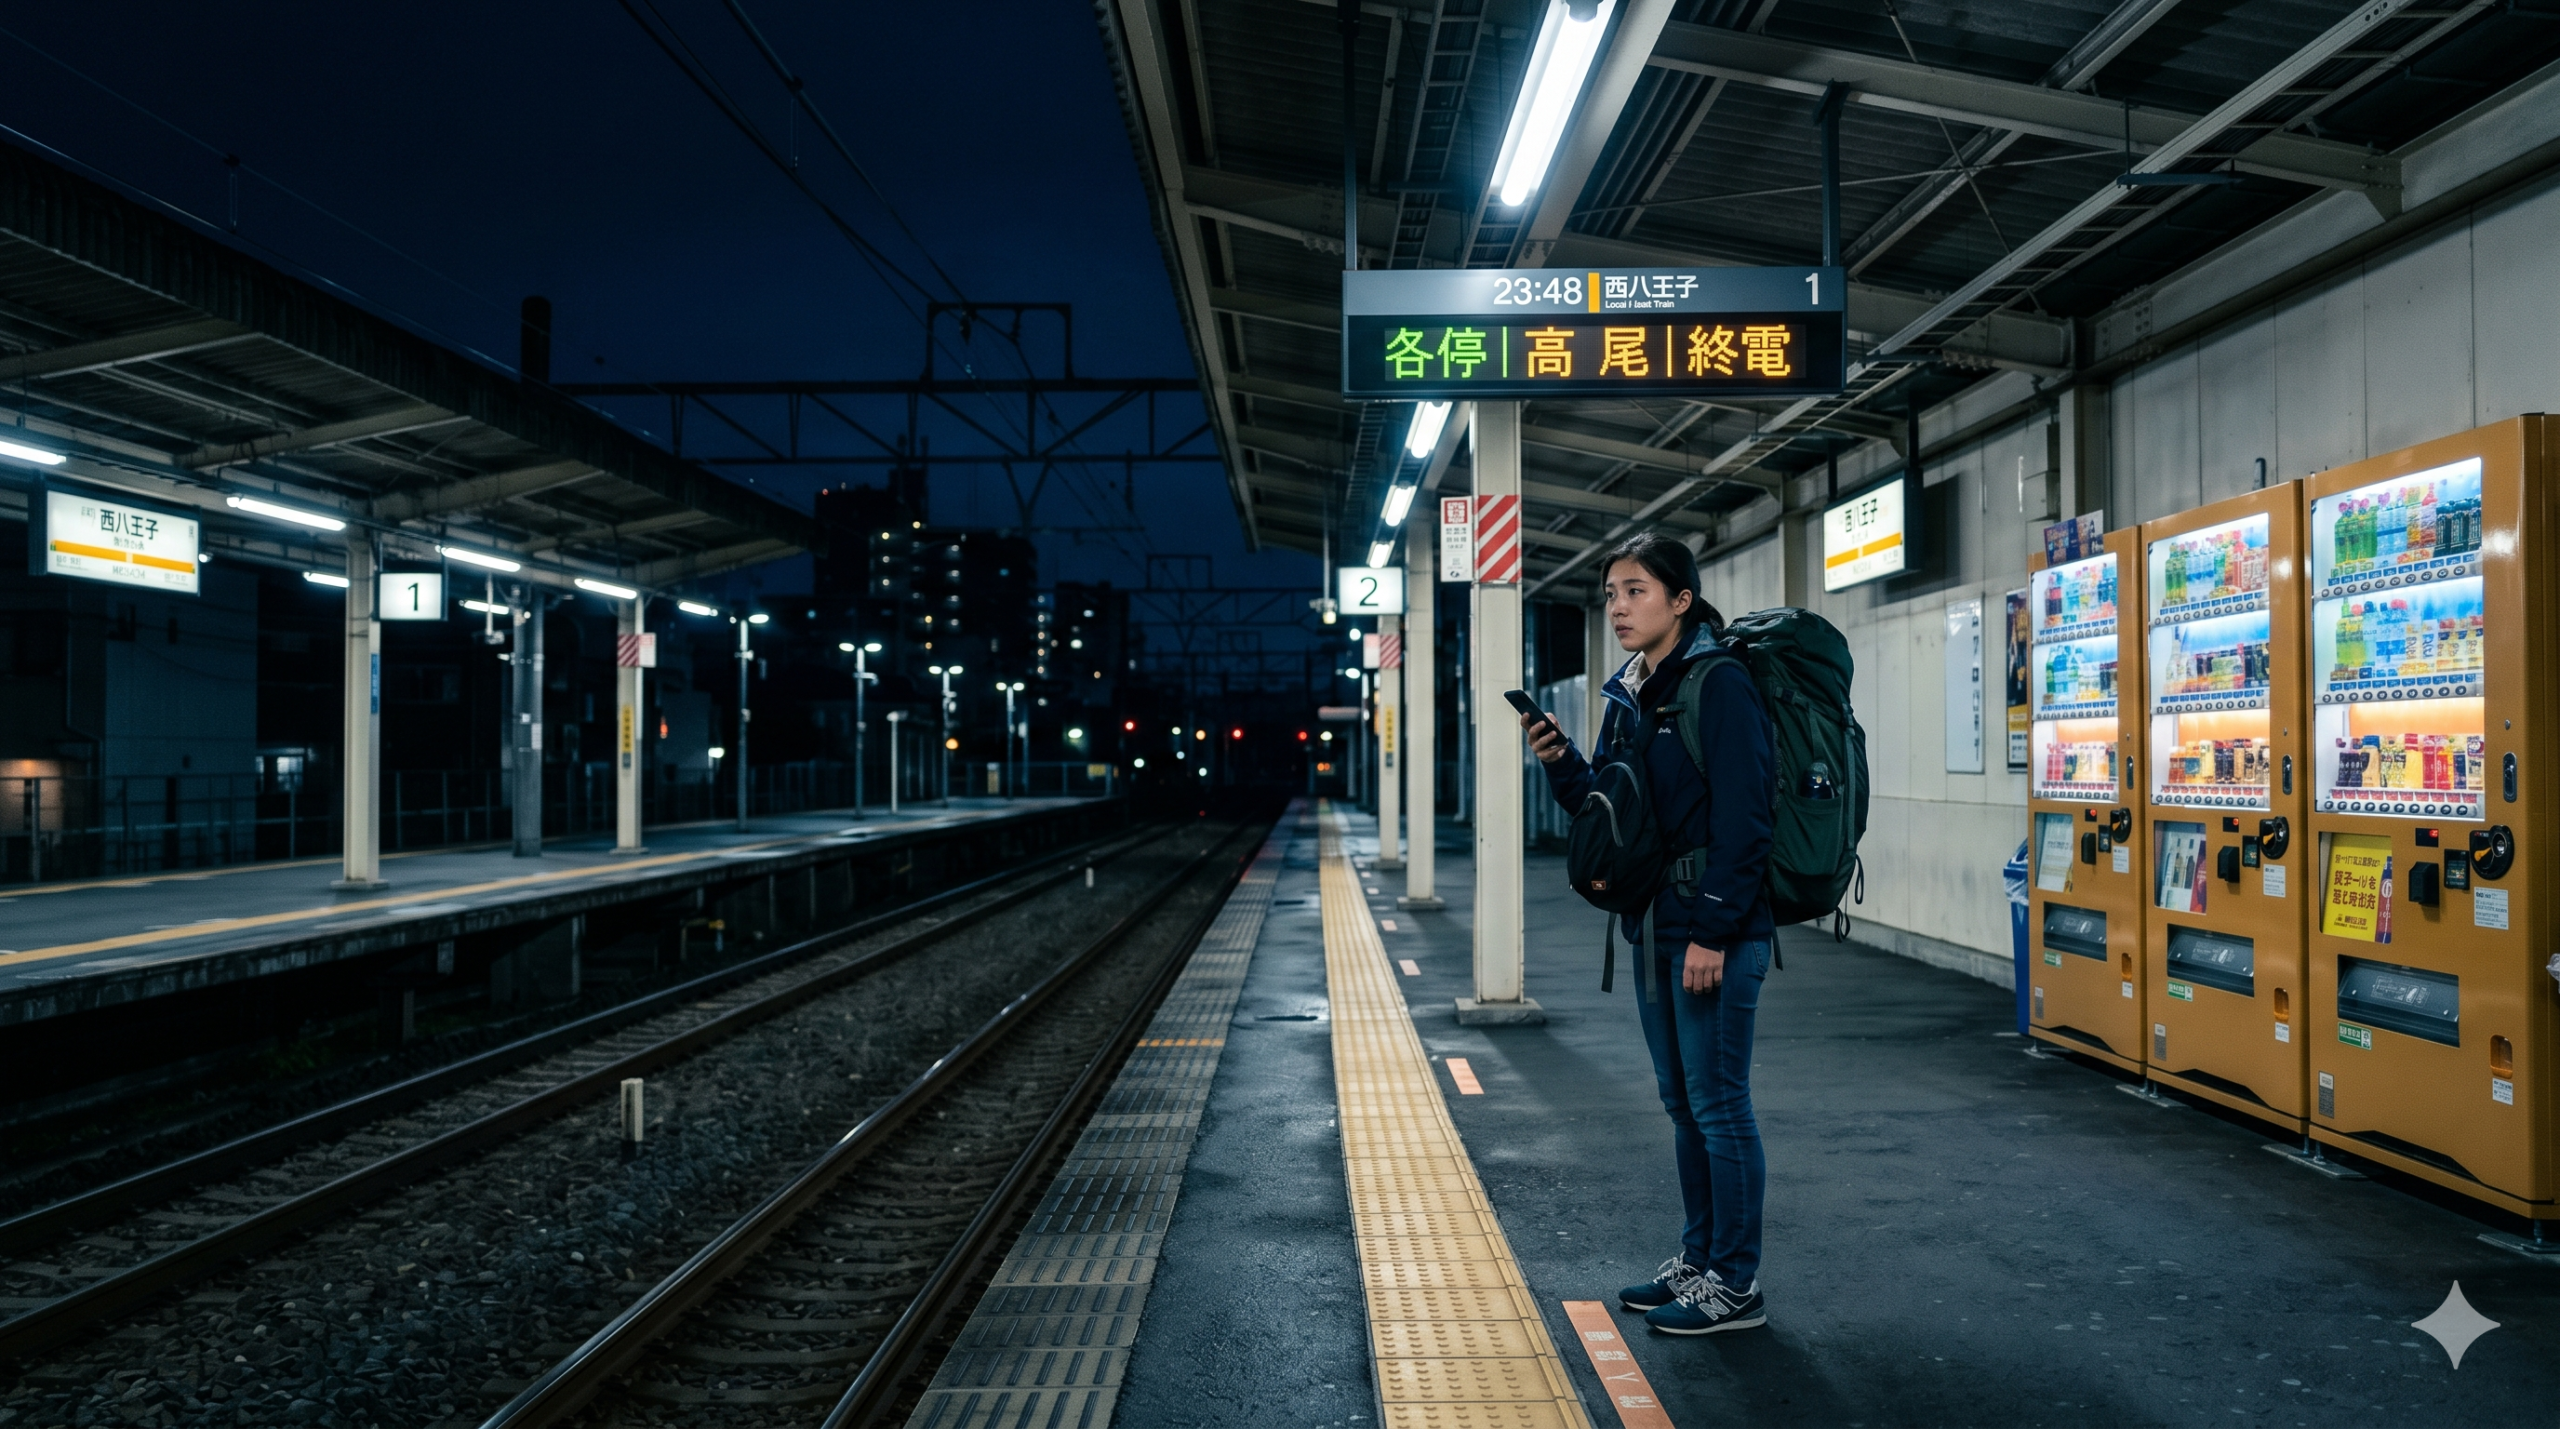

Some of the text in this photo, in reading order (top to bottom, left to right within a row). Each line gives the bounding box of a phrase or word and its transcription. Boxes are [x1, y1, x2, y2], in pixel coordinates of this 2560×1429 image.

[1493, 276, 1582, 305] 23:48
[1604, 275, 1699, 298] 西八王子
[1805, 273, 1819, 305] 1
[1605, 300, 1627, 309] Local
[1653, 300, 1675, 309] Train
[1386, 327, 1487, 378] 各停
[1687, 324, 1791, 377] 終電
[100, 508, 159, 540] 西八王子
[407, 582, 419, 611] 1
[1359, 577, 1379, 607] 2
